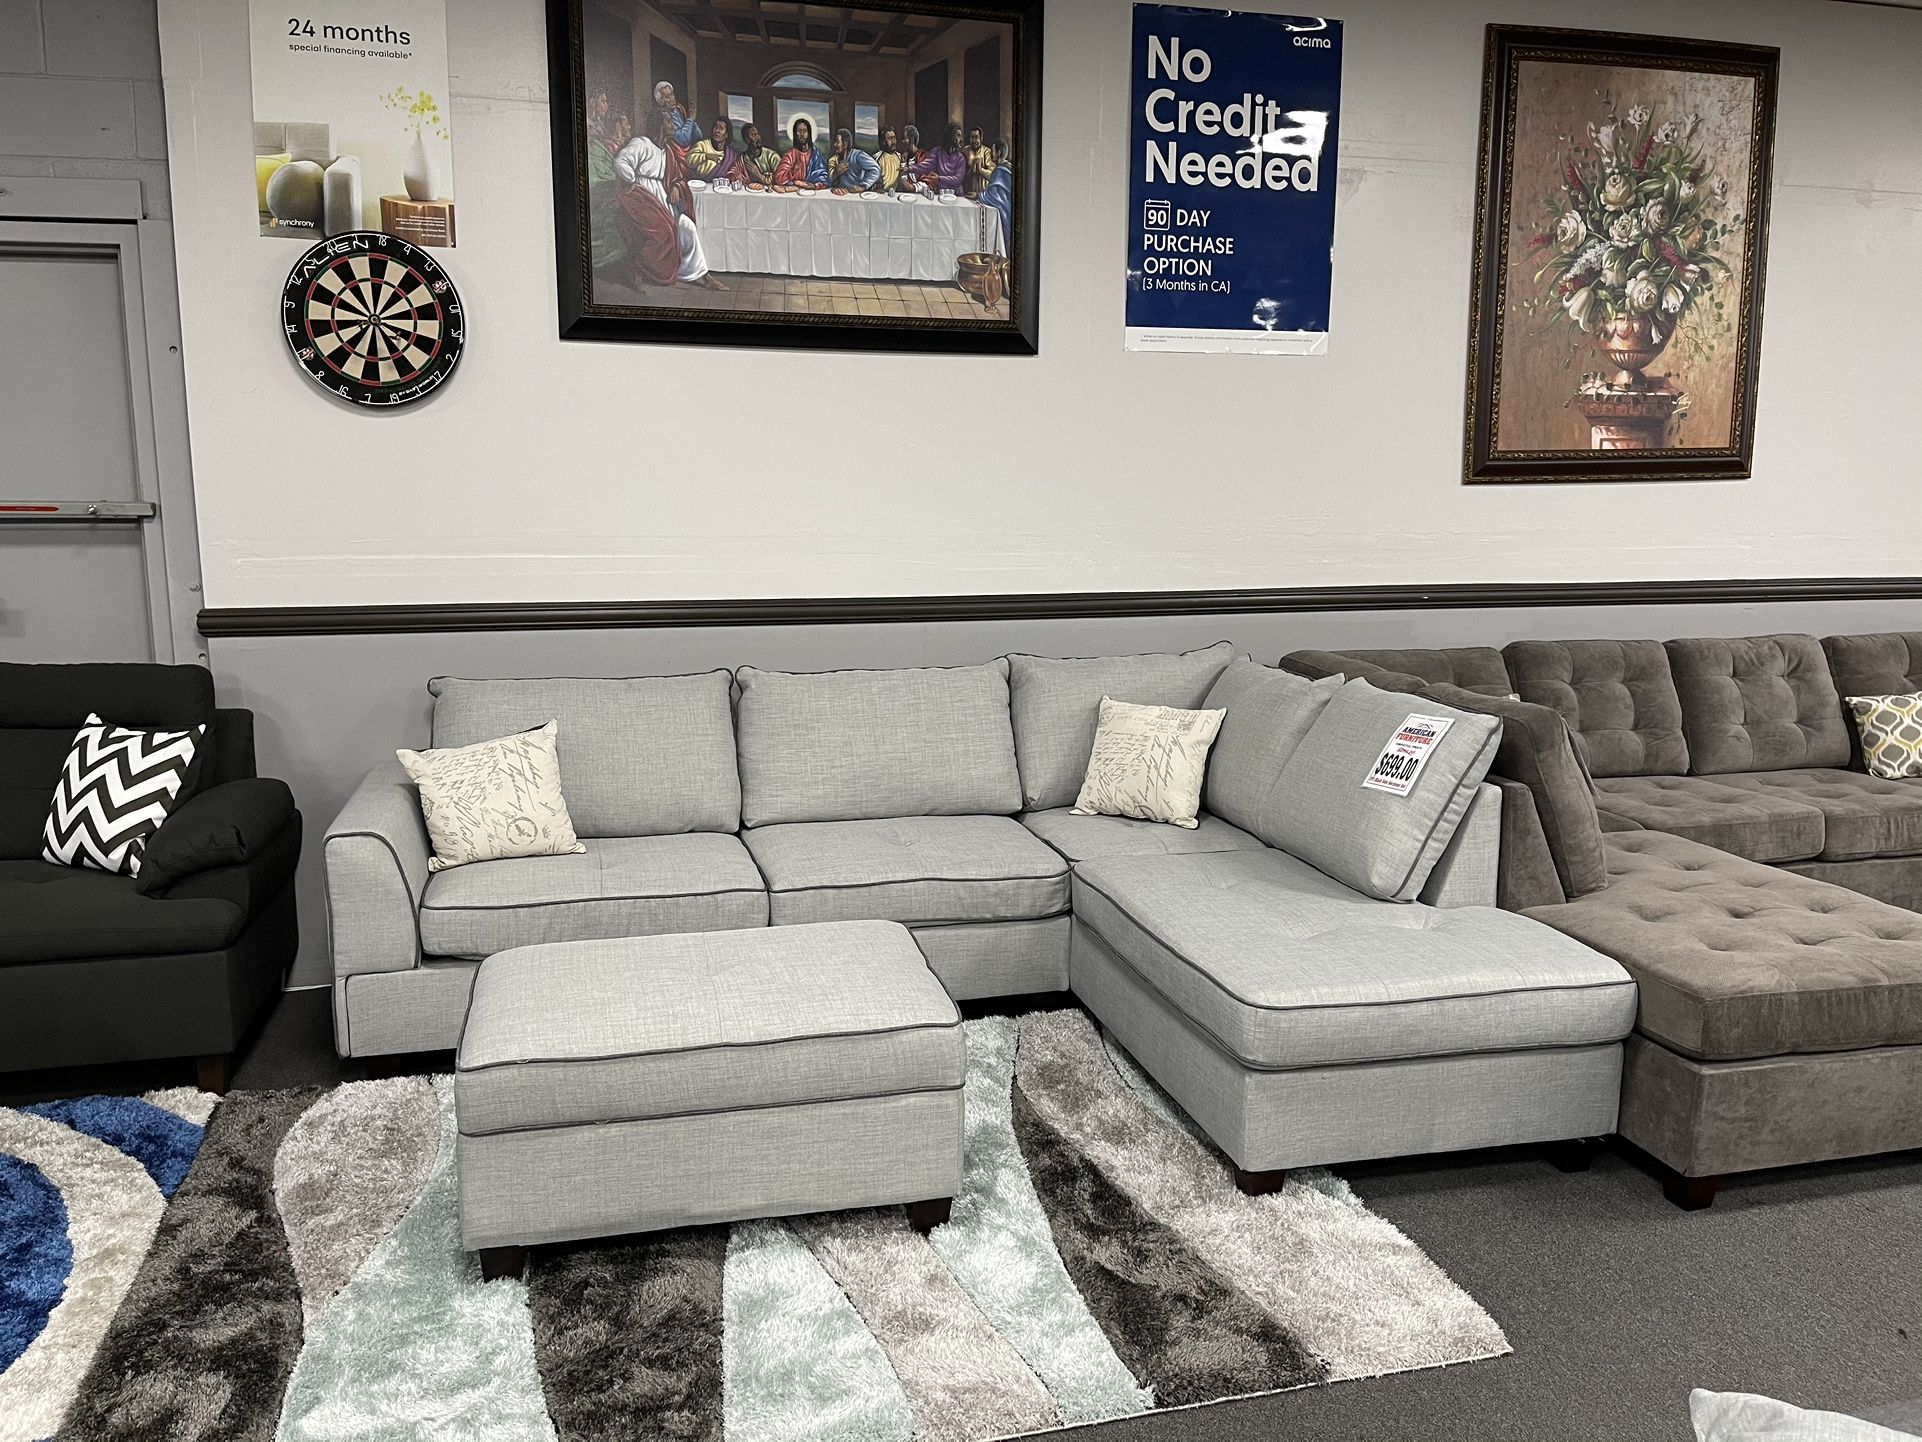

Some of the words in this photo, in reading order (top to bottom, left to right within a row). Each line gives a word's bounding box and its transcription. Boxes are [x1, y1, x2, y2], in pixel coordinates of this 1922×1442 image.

[288, 18, 316, 37] 24
[323, 25, 411, 45] months
[289, 44, 321, 52] special
[324, 45, 365, 57] financing
[1293, 36, 1331, 48] acima
[1147, 35, 1212, 83] No
[1145, 88, 1281, 137] Credit
[1145, 140, 1320, 192] Needed
[279, 219, 315, 228] synchrony
[1148, 209, 1167, 225] 90
[1176, 208, 1211, 228] DAY
[1143, 233, 1234, 255] PURCHASE
[1143, 256, 1212, 276] OPTION
[1155, 278, 1196, 291] Months
[1198, 280, 1208, 292] in
[1210, 280, 1231, 294] CA)
[1396, 733, 1433, 745] FURNITURE
[1402, 727, 1436, 737] AMERICAN
[1374, 752, 1419, 781] $699.00
